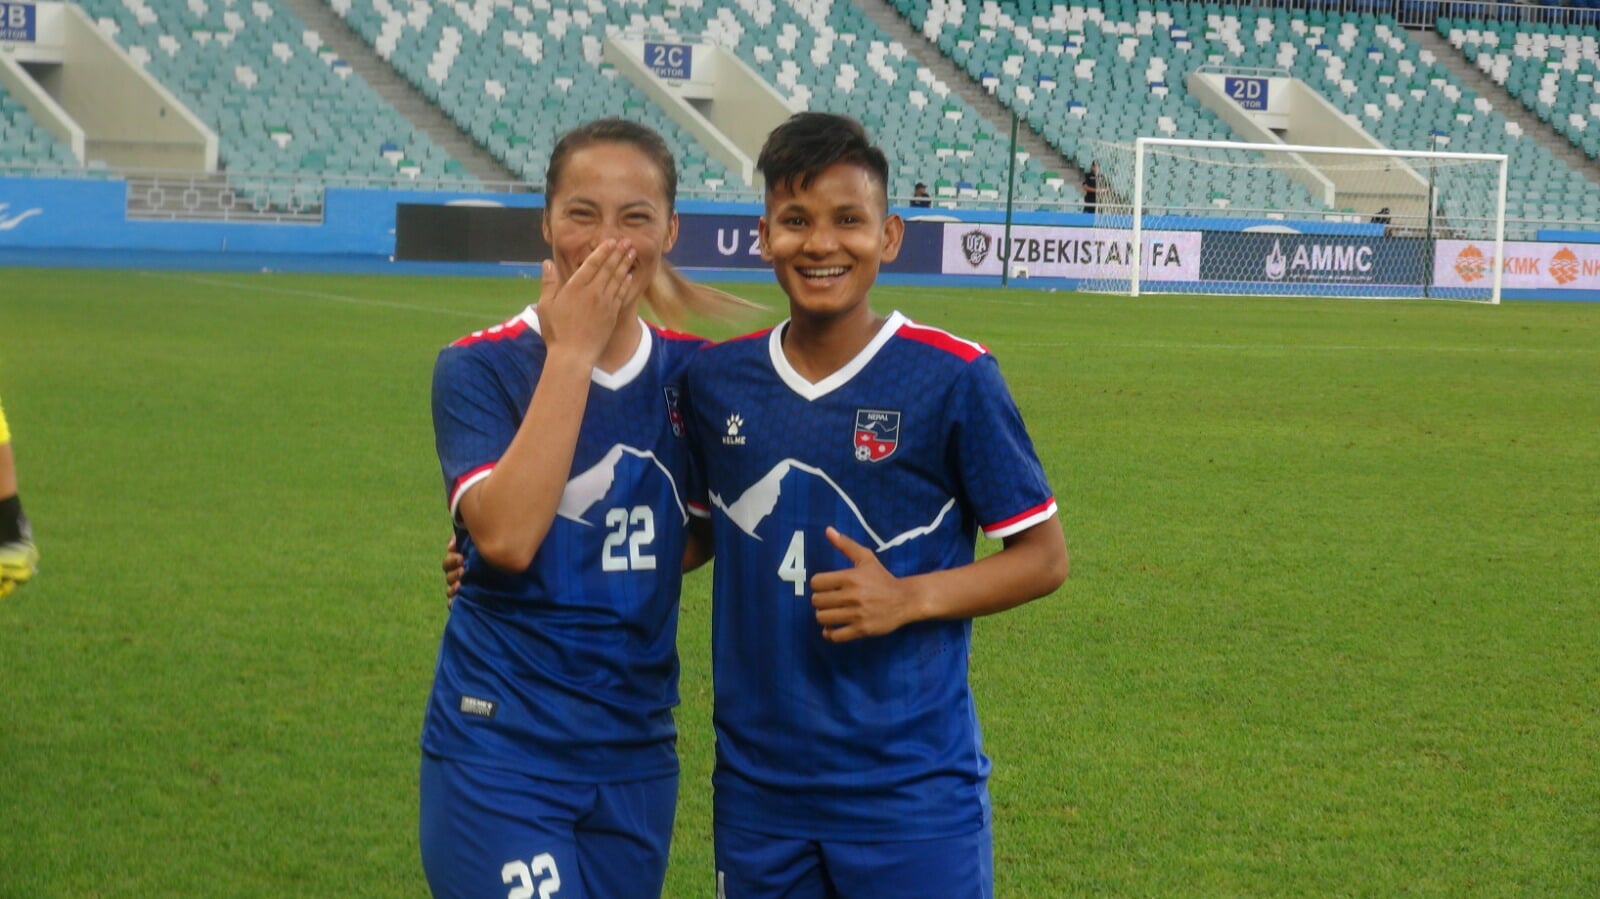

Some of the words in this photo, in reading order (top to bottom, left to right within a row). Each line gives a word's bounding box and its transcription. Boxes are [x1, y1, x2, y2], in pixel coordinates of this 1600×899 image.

[653, 46, 683, 67] 2C
[1233, 79, 1261, 99] 2D
[966, 234, 987, 252] UFA
[997, 237, 1142, 267] UZBEKISTAN
[1152, 242, 1181, 267] FA
[1290, 244, 1373, 272] AMMC
[602, 505, 657, 571] 22
[777, 530, 807, 596] 4
[501, 852, 561, 899] 22
